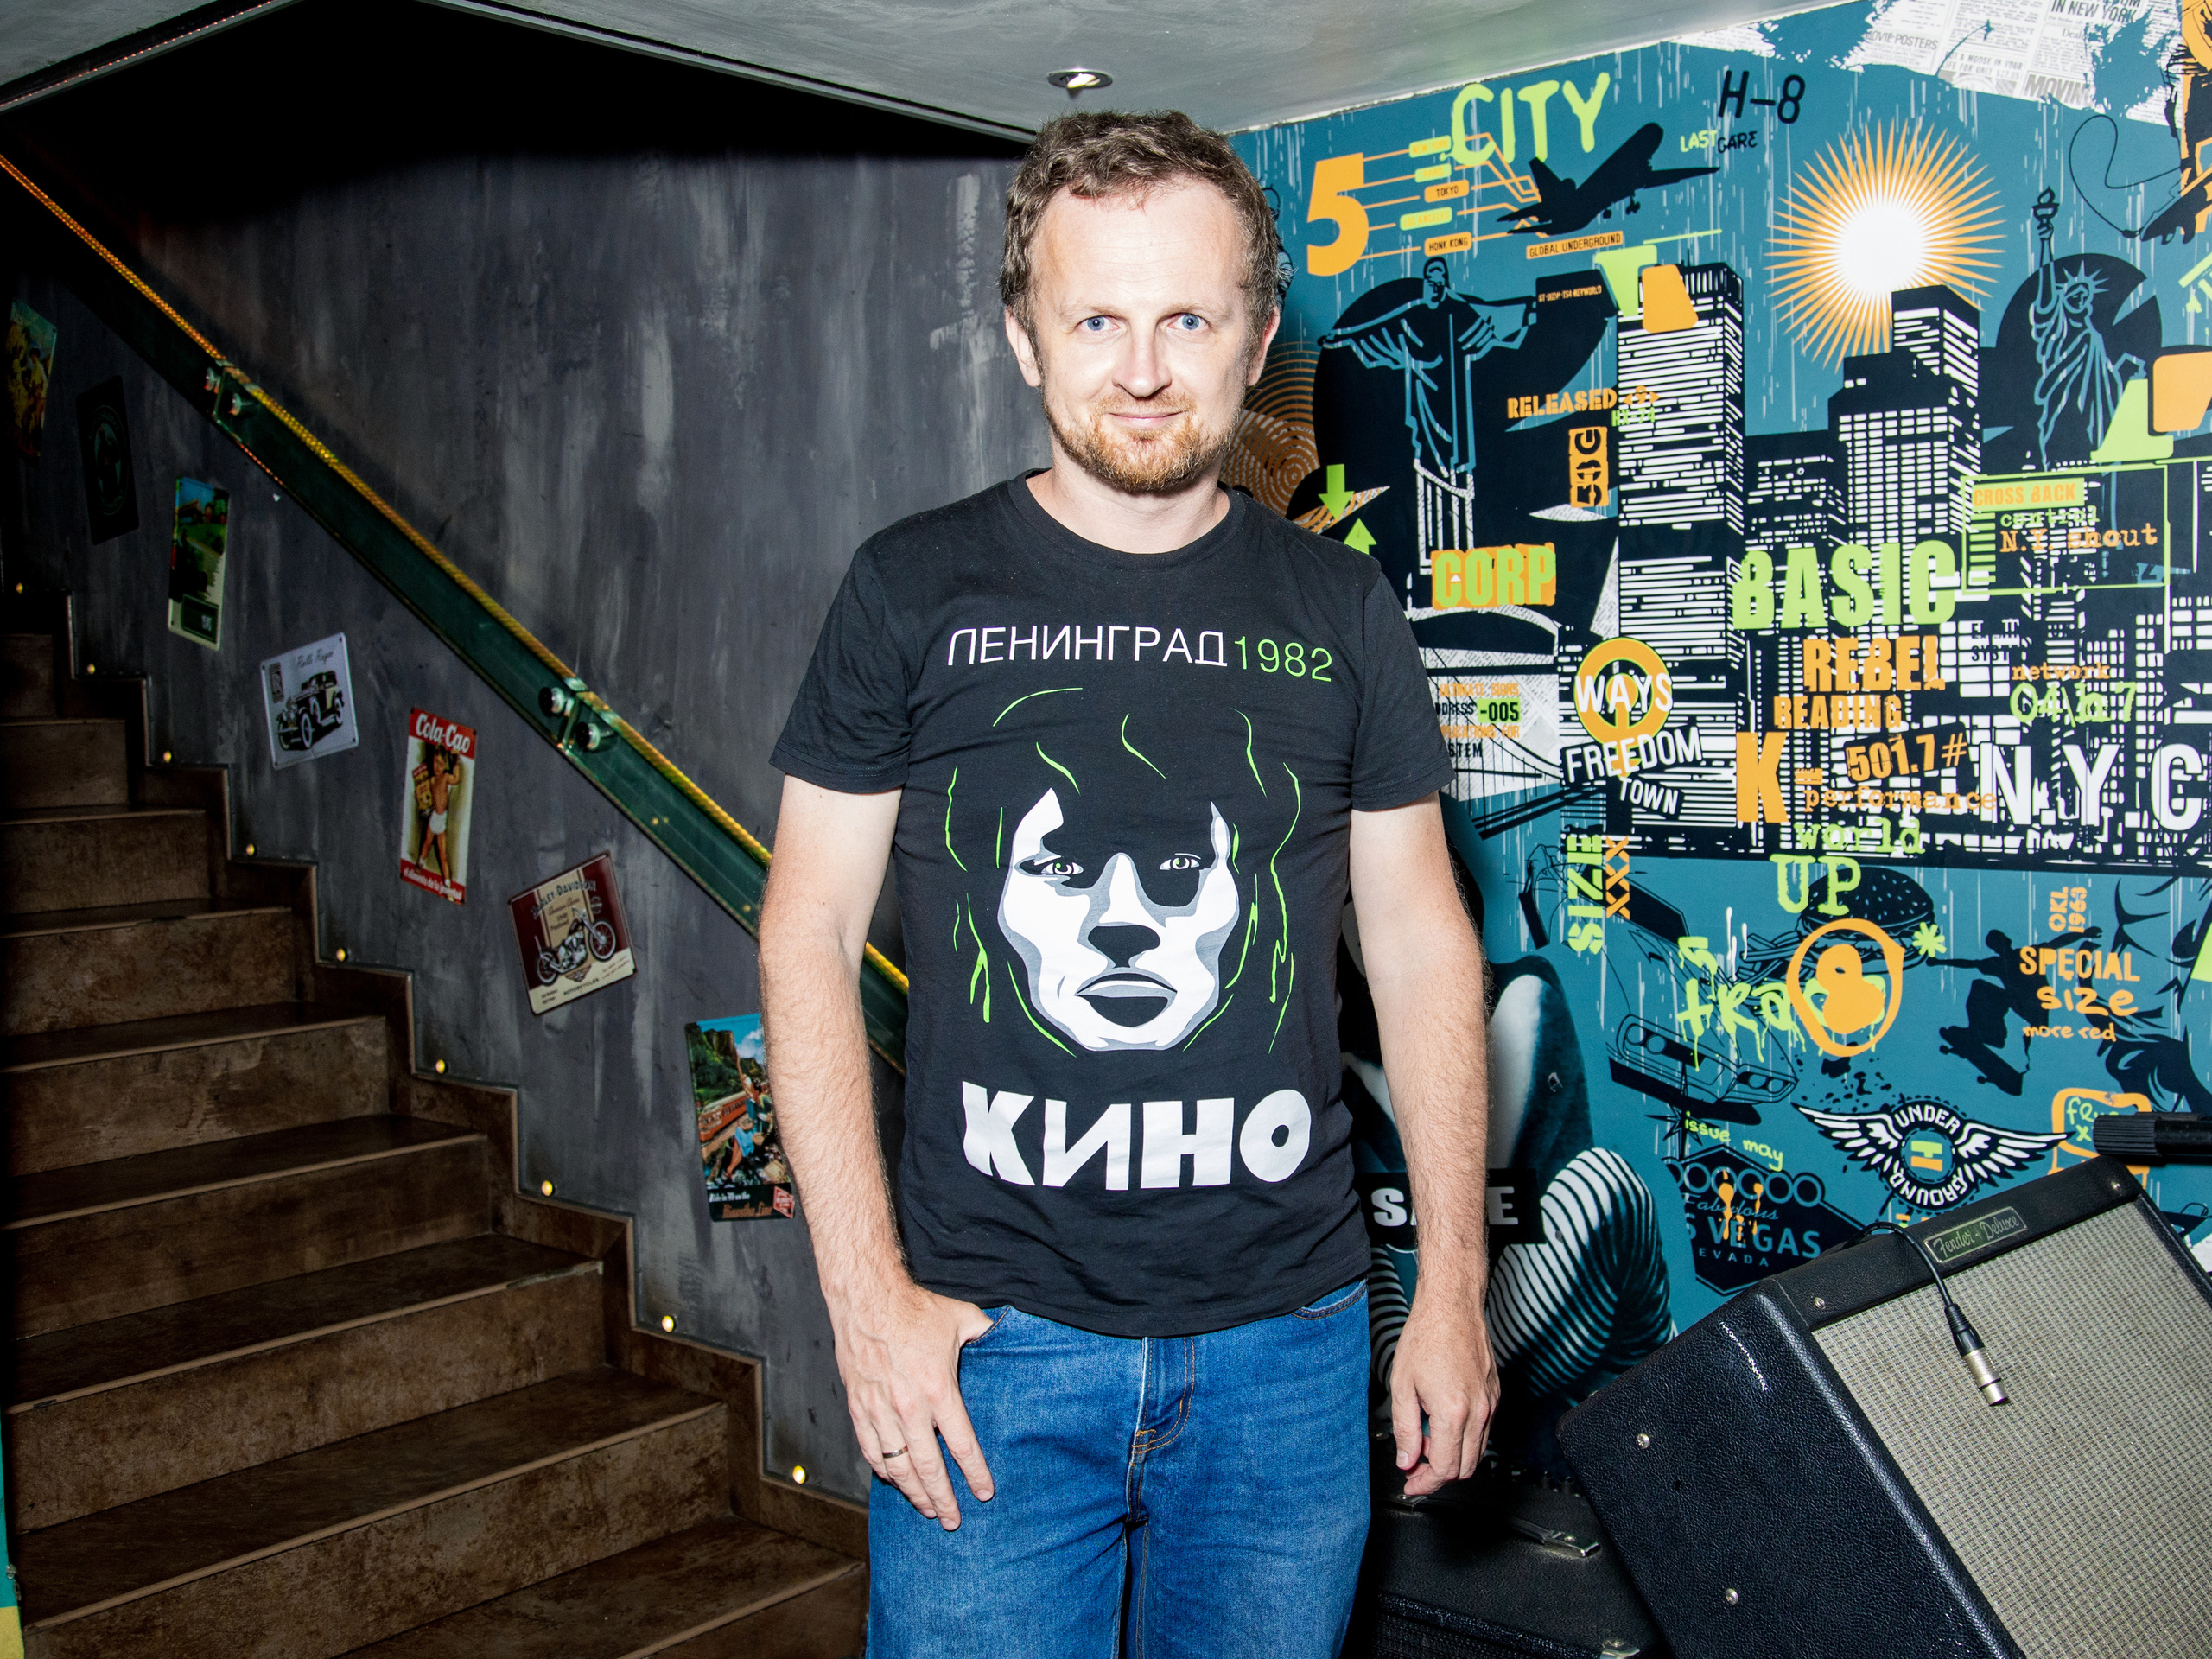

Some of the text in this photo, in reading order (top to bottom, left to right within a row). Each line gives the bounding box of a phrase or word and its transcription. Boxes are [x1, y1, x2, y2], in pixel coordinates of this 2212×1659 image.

[2068, 1, 2099, 17] NEW
[2102, 6, 2137, 23] YORK
[1895, 33, 1939, 50] POSTERS
[1717, 70, 1806, 124] H-8
[1451, 72, 1611, 167] CITY
[1680, 129, 1718, 152] LAST
[1436, 185, 1459, 198] TOKYO
[1306, 152, 1370, 276] 5
[1449, 236, 1469, 248] KONG
[1529, 233, 1622, 257] GLOBAL UNDERGROUND
[1507, 388, 1618, 419] RELEASED
[1973, 482, 2077, 507] CROSS BACK
[1999, 505, 2101, 527] control
[2067, 522, 2158, 549] shout
[1434, 545, 1556, 607] CORP
[1732, 539, 1956, 630] BASIC
[948, 625, 1332, 683] ЛЕНИНГРАД 1982
[1803, 635, 1946, 692] REBEL
[2011, 661, 2111, 681] network
[1440, 683, 1485, 697] ULTIMATE
[1574, 672, 1673, 715] WAYS
[1774, 694, 1902, 730] READING
[416, 712, 471, 753] Cola-Cao
[1448, 742, 1483, 758] STEM
[1501, 725, 1520, 739] FOR
[1565, 726, 1703, 783] FREEDOM
[1619, 776, 1679, 815] TOWN
[1802, 785, 1997, 812] performance
[1794, 817, 1926, 854] world
[1567, 835, 1604, 955] SIZE
[1770, 854, 1861, 916] UP
[2019, 946, 2141, 982] SPECIAL
[2022, 1021, 2118, 1043] more red
[962, 1081, 1313, 1192] КИНО
[1893, 1104, 1961, 1135] UNDER
[1685, 1110, 1784, 1173] issue may
[1890, 1170, 1968, 1206] GROUND
[1370, 1186, 1519, 1227] SE
[1707, 1217, 1821, 1259] VEGAS
[1933, 1214, 2020, 1258] Fender Deluxe
[1699, 1248, 1770, 1268] EVADA
